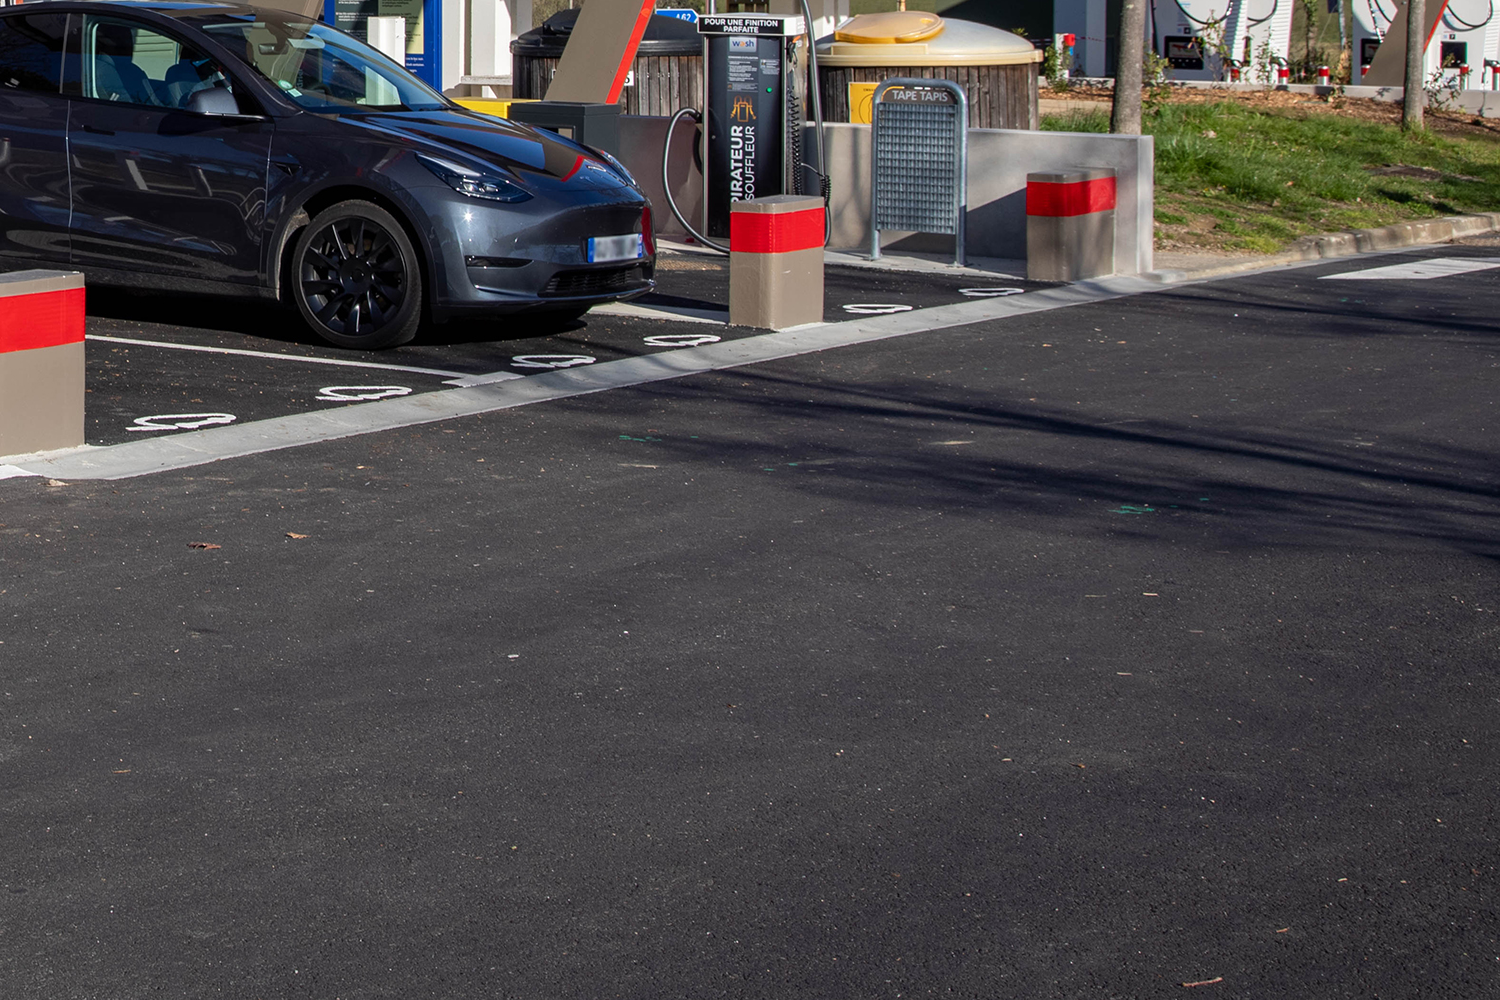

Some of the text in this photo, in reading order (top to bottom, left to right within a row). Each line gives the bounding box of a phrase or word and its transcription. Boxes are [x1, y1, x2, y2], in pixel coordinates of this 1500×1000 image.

[704, 18, 778, 27] POUR UNE FINITION
[732, 39, 755, 47] wash
[892, 90, 948, 102] TAPE TAPIS
[730, 125, 743, 203] PIRATEUR
[745, 126, 755, 201] SOUFFLEUR
